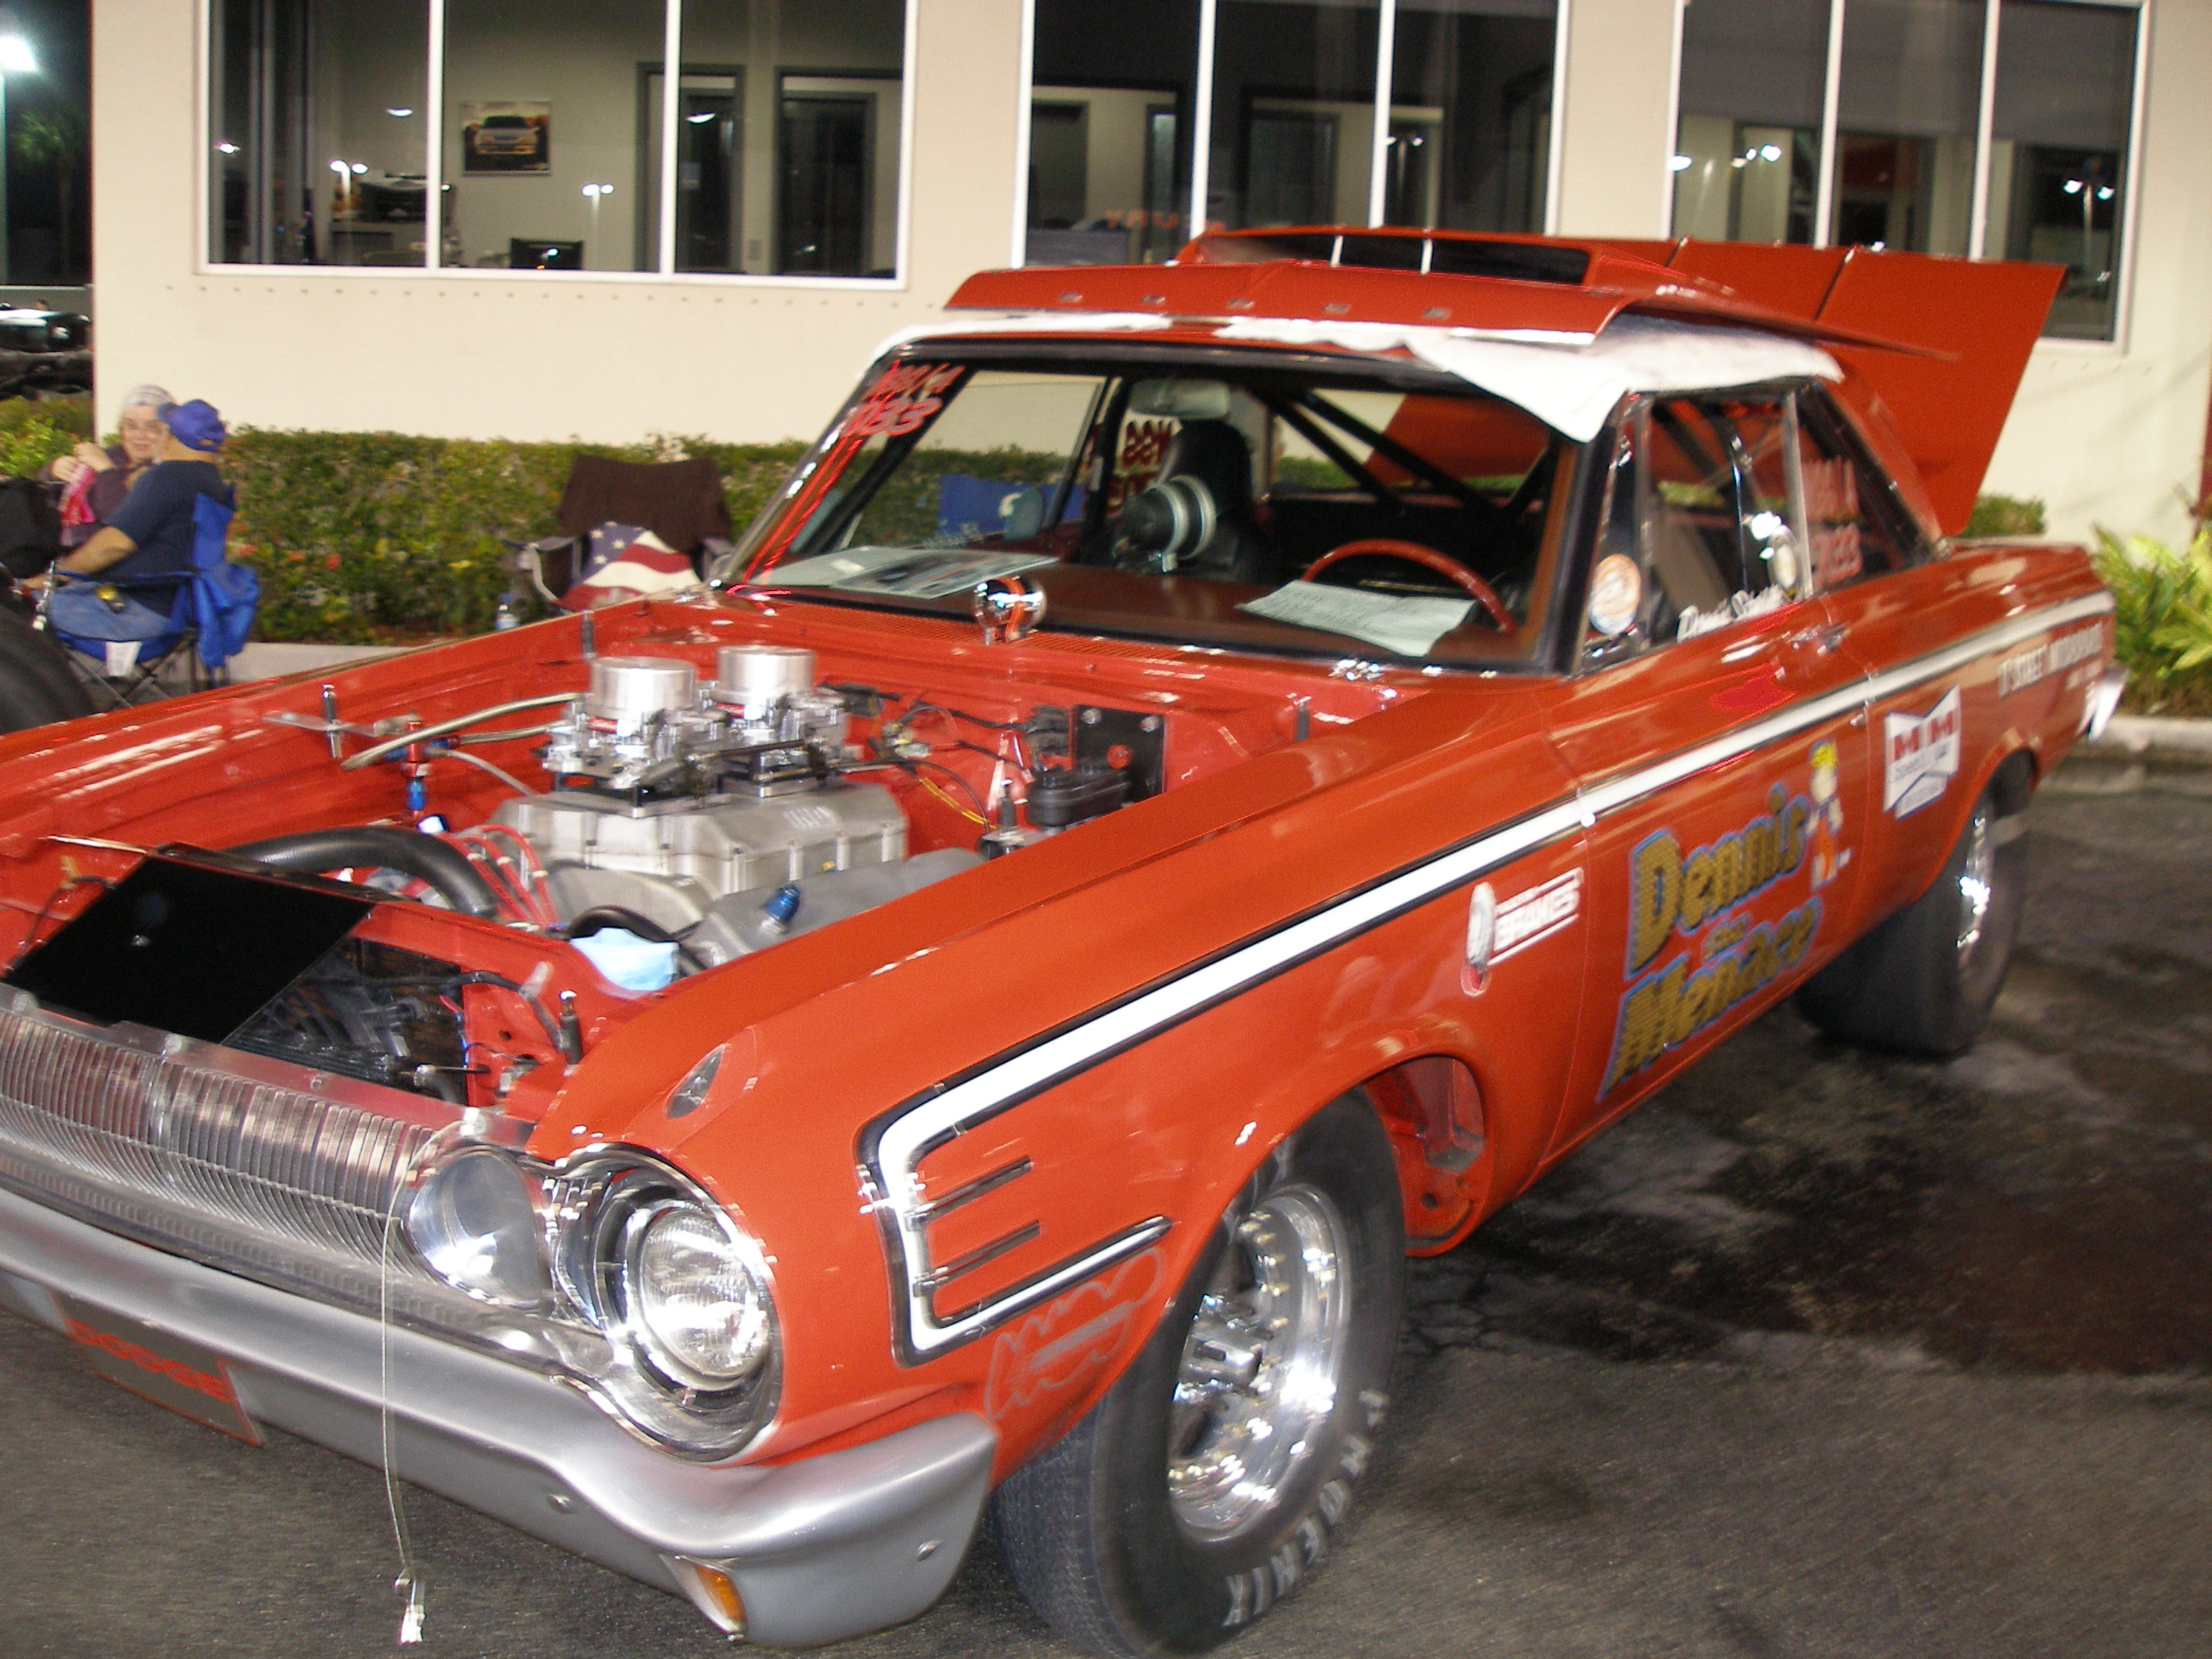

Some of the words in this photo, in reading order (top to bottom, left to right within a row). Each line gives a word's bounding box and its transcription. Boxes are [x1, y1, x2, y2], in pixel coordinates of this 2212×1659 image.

[1624, 781, 1809, 981] Dennis
[1595, 895, 1823, 1102] Menace
[63, 1316, 239, 1404] DODGE
